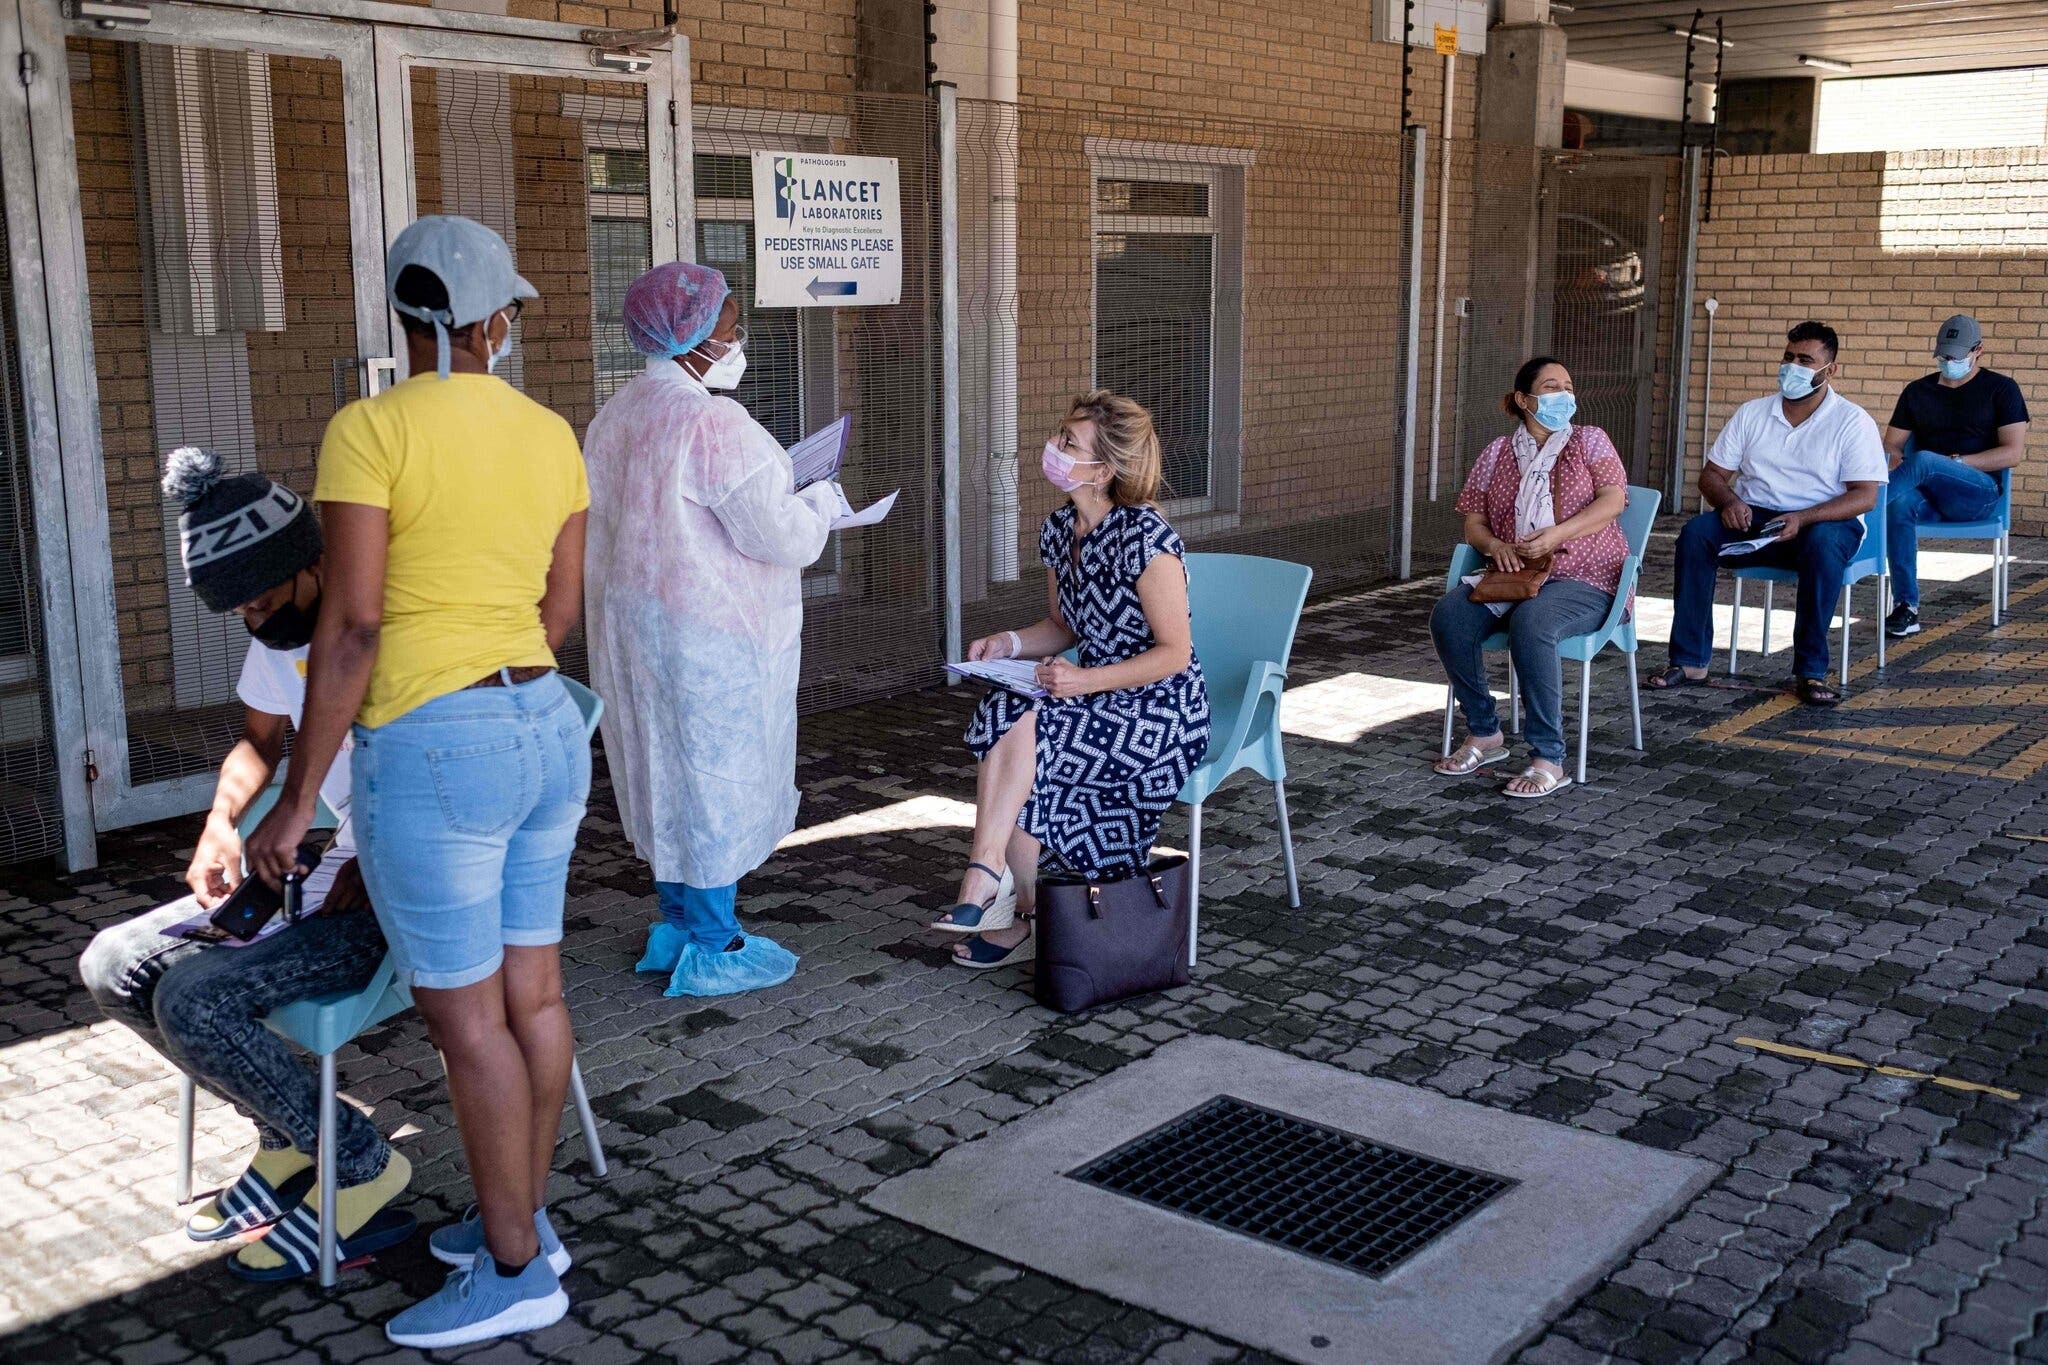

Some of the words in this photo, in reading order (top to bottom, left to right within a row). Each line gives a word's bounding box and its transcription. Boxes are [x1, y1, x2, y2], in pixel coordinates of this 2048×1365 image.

[801, 158, 846, 166] PATHOLOGISTS
[801, 179, 880, 202] LANCET
[802, 208, 882, 220] LABORATORIES
[822, 227, 852, 235] Diagnostic
[765, 238, 847, 251] PEDESTRIANS
[851, 240, 893, 251] PLEASE
[781, 257, 804, 269] USE
[808, 257, 847, 269] SMALL
[851, 257, 880, 269] GATE
